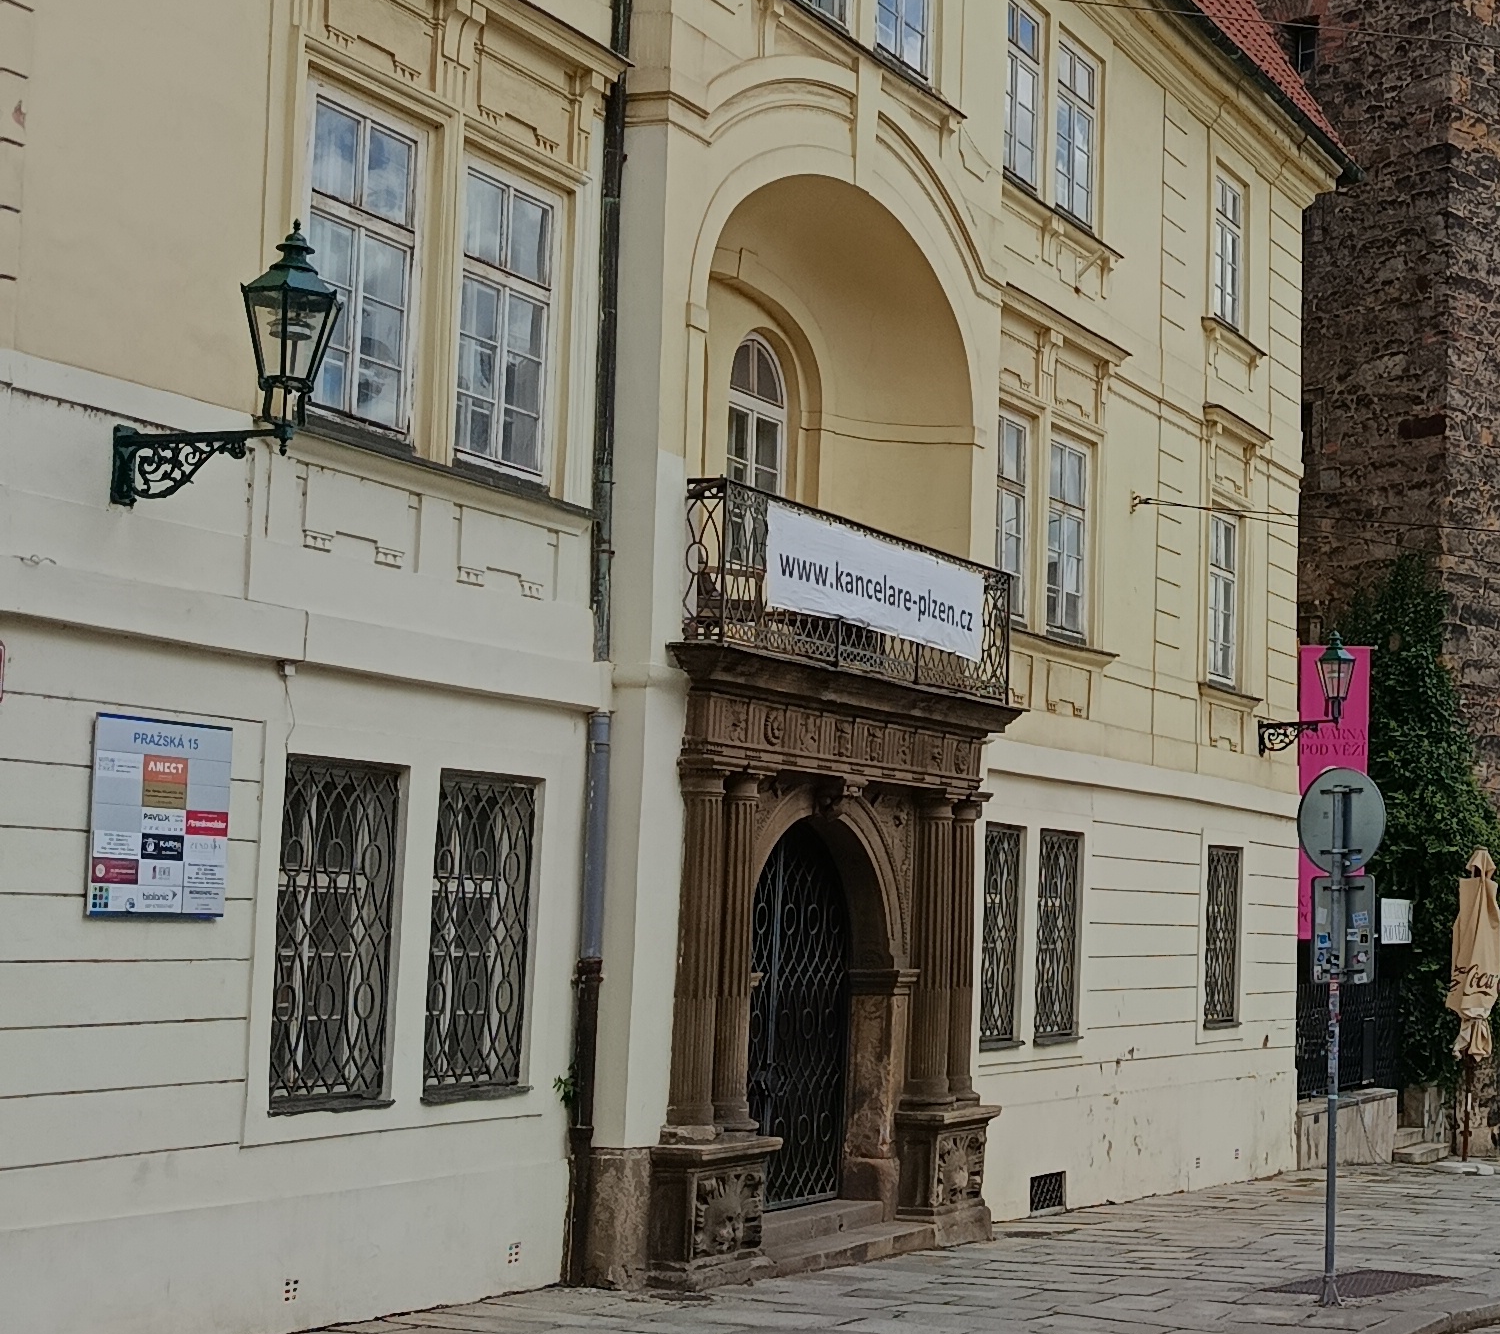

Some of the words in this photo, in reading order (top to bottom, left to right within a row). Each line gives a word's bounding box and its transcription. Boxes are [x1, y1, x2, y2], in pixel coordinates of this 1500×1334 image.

[779, 552, 974, 633] www.kancelare-plzen.cz
[133, 731, 185, 749] PRAŽSKÁ
[187, 738, 199, 751] 15
[1301, 743, 1329, 756] POD
[1332, 741, 1367, 757] VĚŽÍ
[148, 761, 184, 774] ANECT
